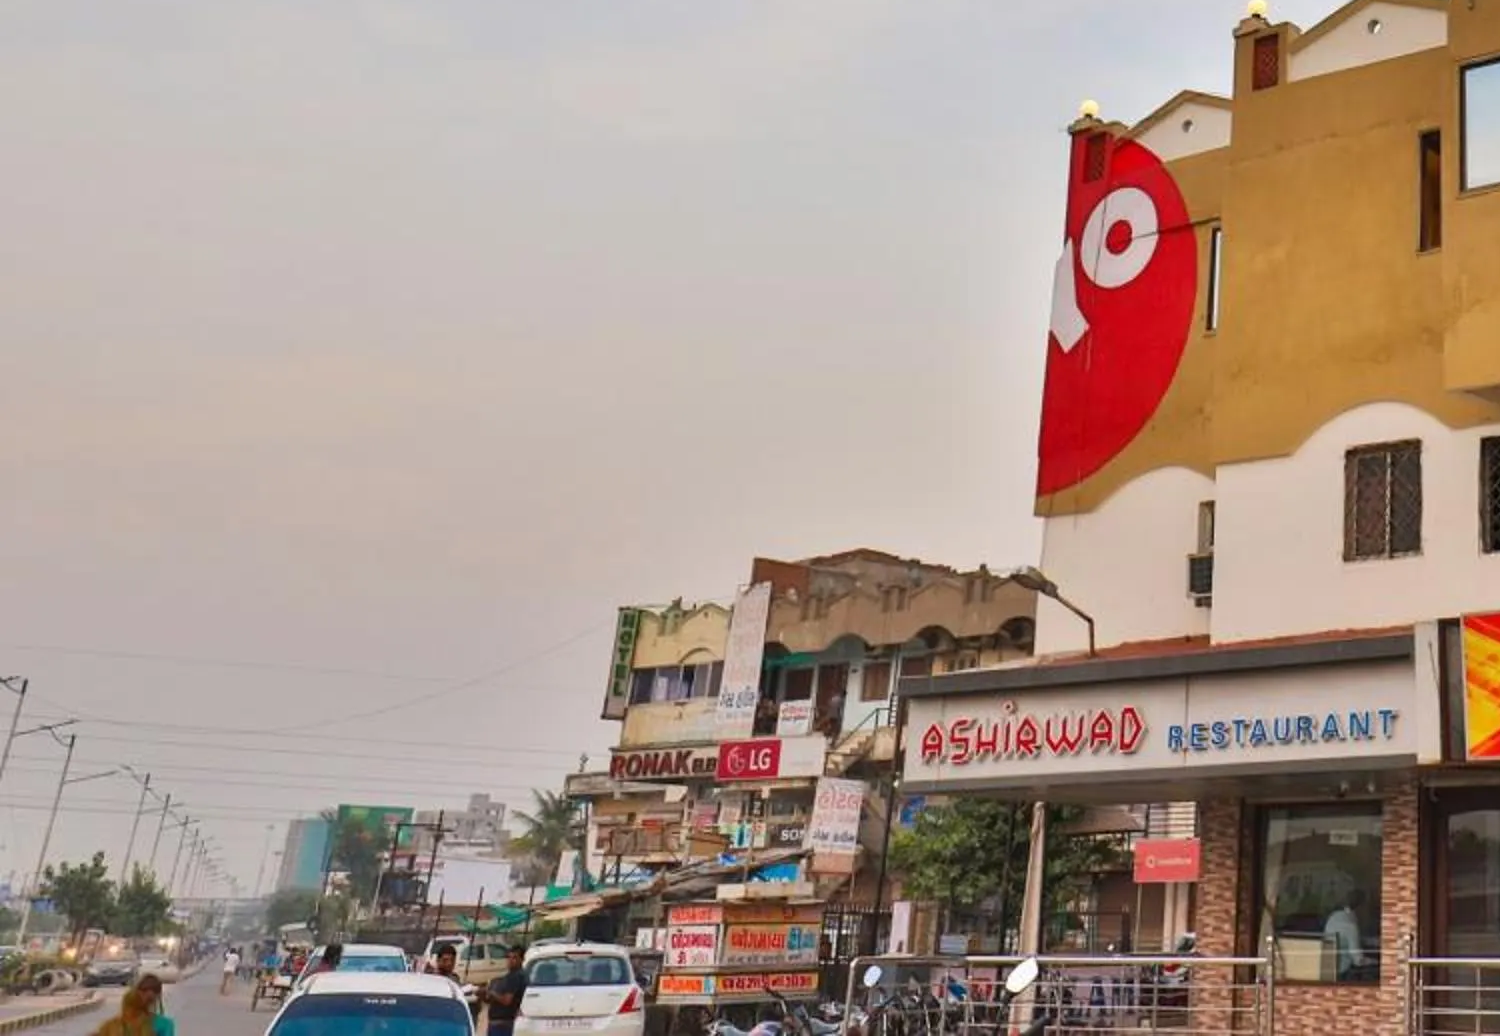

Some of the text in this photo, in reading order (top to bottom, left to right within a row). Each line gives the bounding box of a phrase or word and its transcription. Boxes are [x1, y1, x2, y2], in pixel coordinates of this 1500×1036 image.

[613, 613, 636, 696] HOTEL
[1167, 709, 1395, 751] RESTAURANT
[610, 750, 693, 778] RONAK
[749, 747, 772, 770] LG
